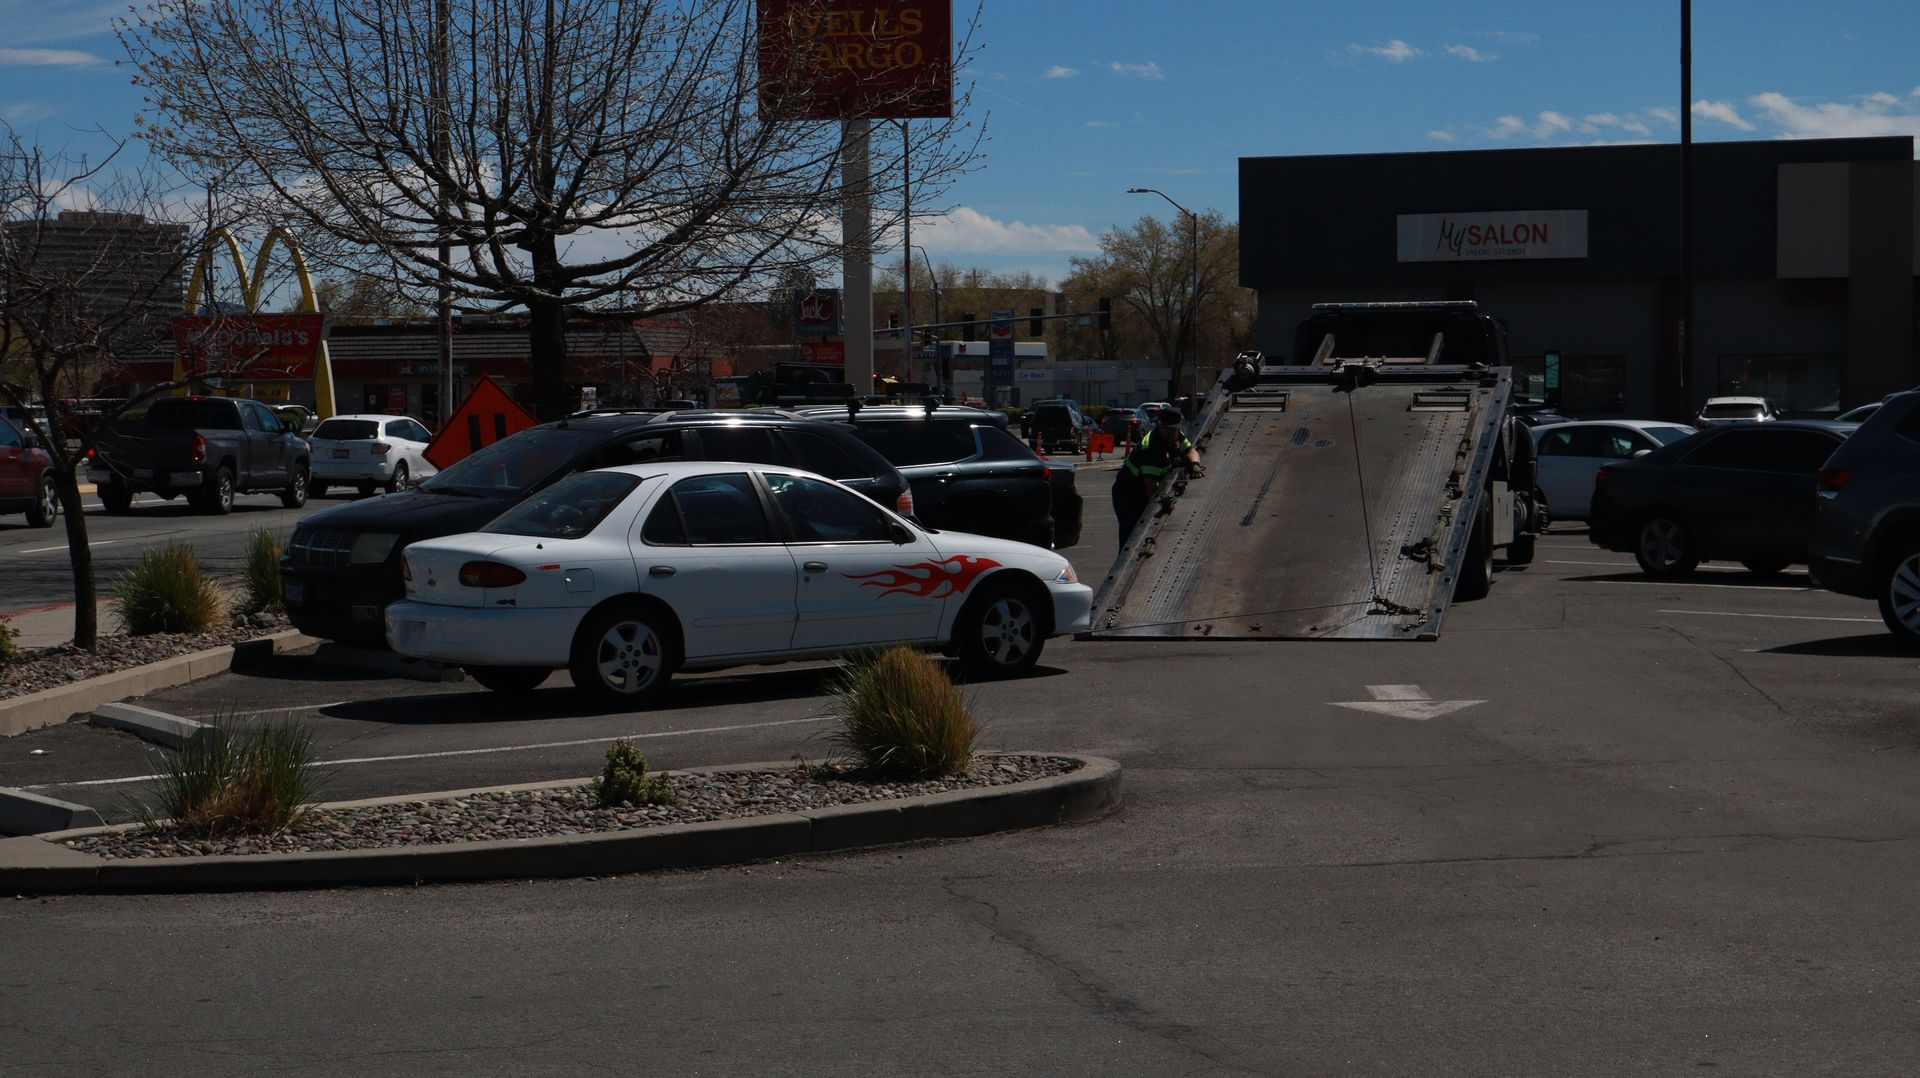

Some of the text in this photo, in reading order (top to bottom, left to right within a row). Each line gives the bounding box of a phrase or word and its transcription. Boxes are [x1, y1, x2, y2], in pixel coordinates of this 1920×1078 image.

[1436, 217, 1548, 257] My SALON
[1466, 247, 1527, 256] SALON STUDIOS
[799, 297, 833, 321] Jack
